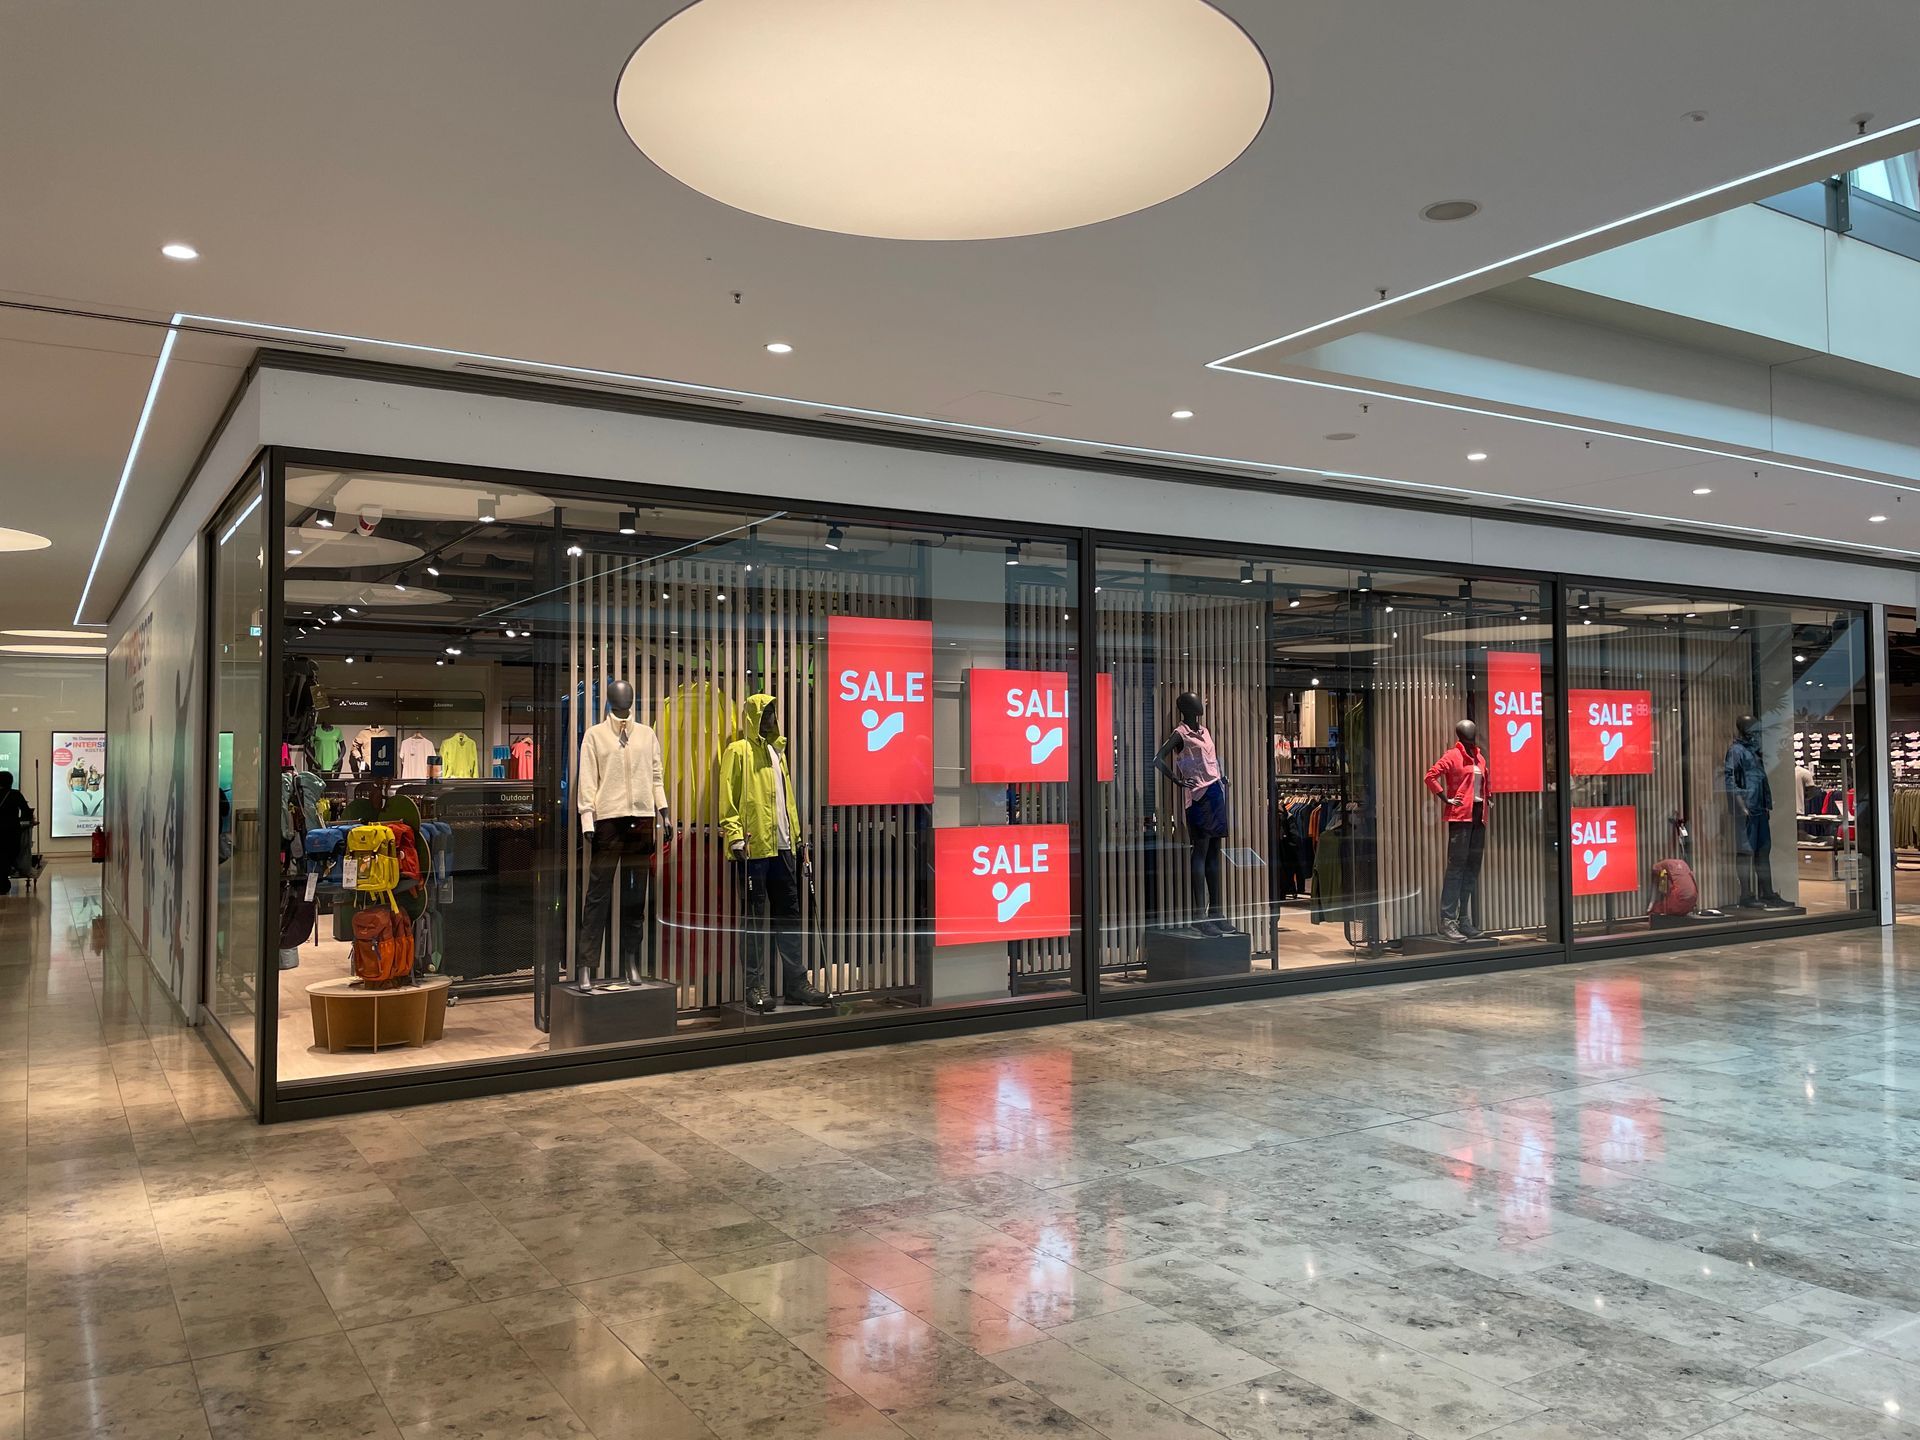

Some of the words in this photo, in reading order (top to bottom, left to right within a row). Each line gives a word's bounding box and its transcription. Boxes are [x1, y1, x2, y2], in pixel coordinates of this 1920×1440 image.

[839, 669, 925, 703] SALE
[1494, 691, 1543, 716] SALE
[1588, 702, 1633, 726] SALE
[500, 793, 530, 801] Outdoor
[1571, 820, 1618, 846] SALE
[971, 843, 1049, 876] SALE
